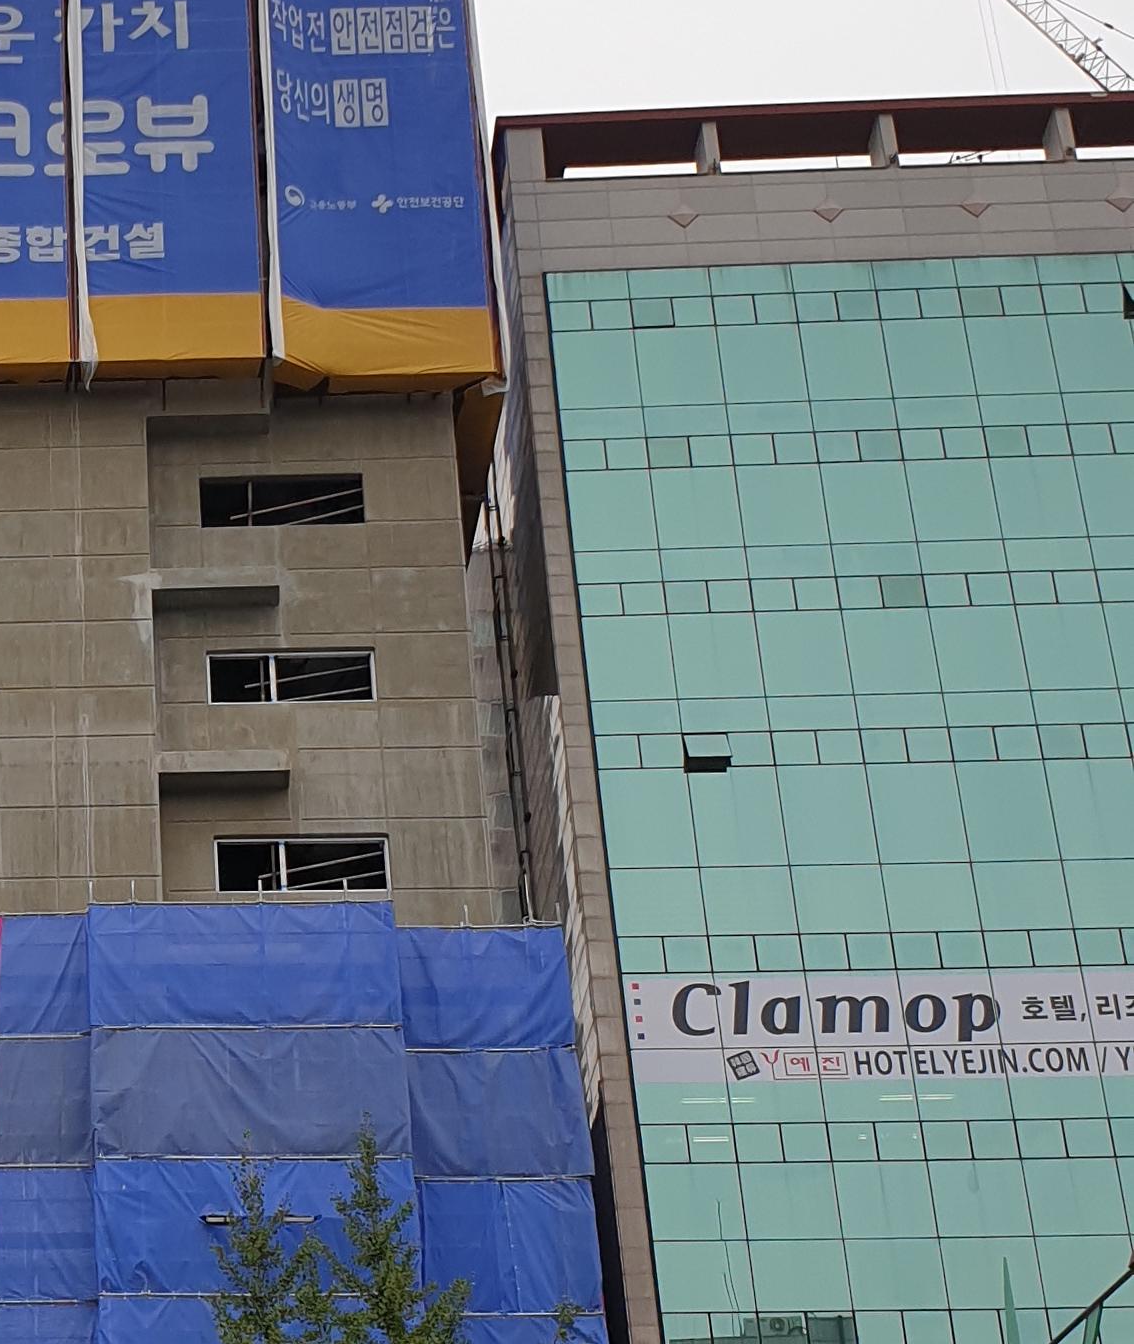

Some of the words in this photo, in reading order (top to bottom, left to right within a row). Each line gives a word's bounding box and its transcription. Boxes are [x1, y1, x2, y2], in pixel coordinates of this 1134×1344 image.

[54, 0, 192, 53] 가치
[276, 69, 330, 125] 당신의
[335, 79, 387, 126] 생명
[396, 196, 465, 209] 안전보건공단
[671, 979, 1001, 1042] Clamop
[855, 1046, 1090, 1076] HOTELYEJIN.COM
